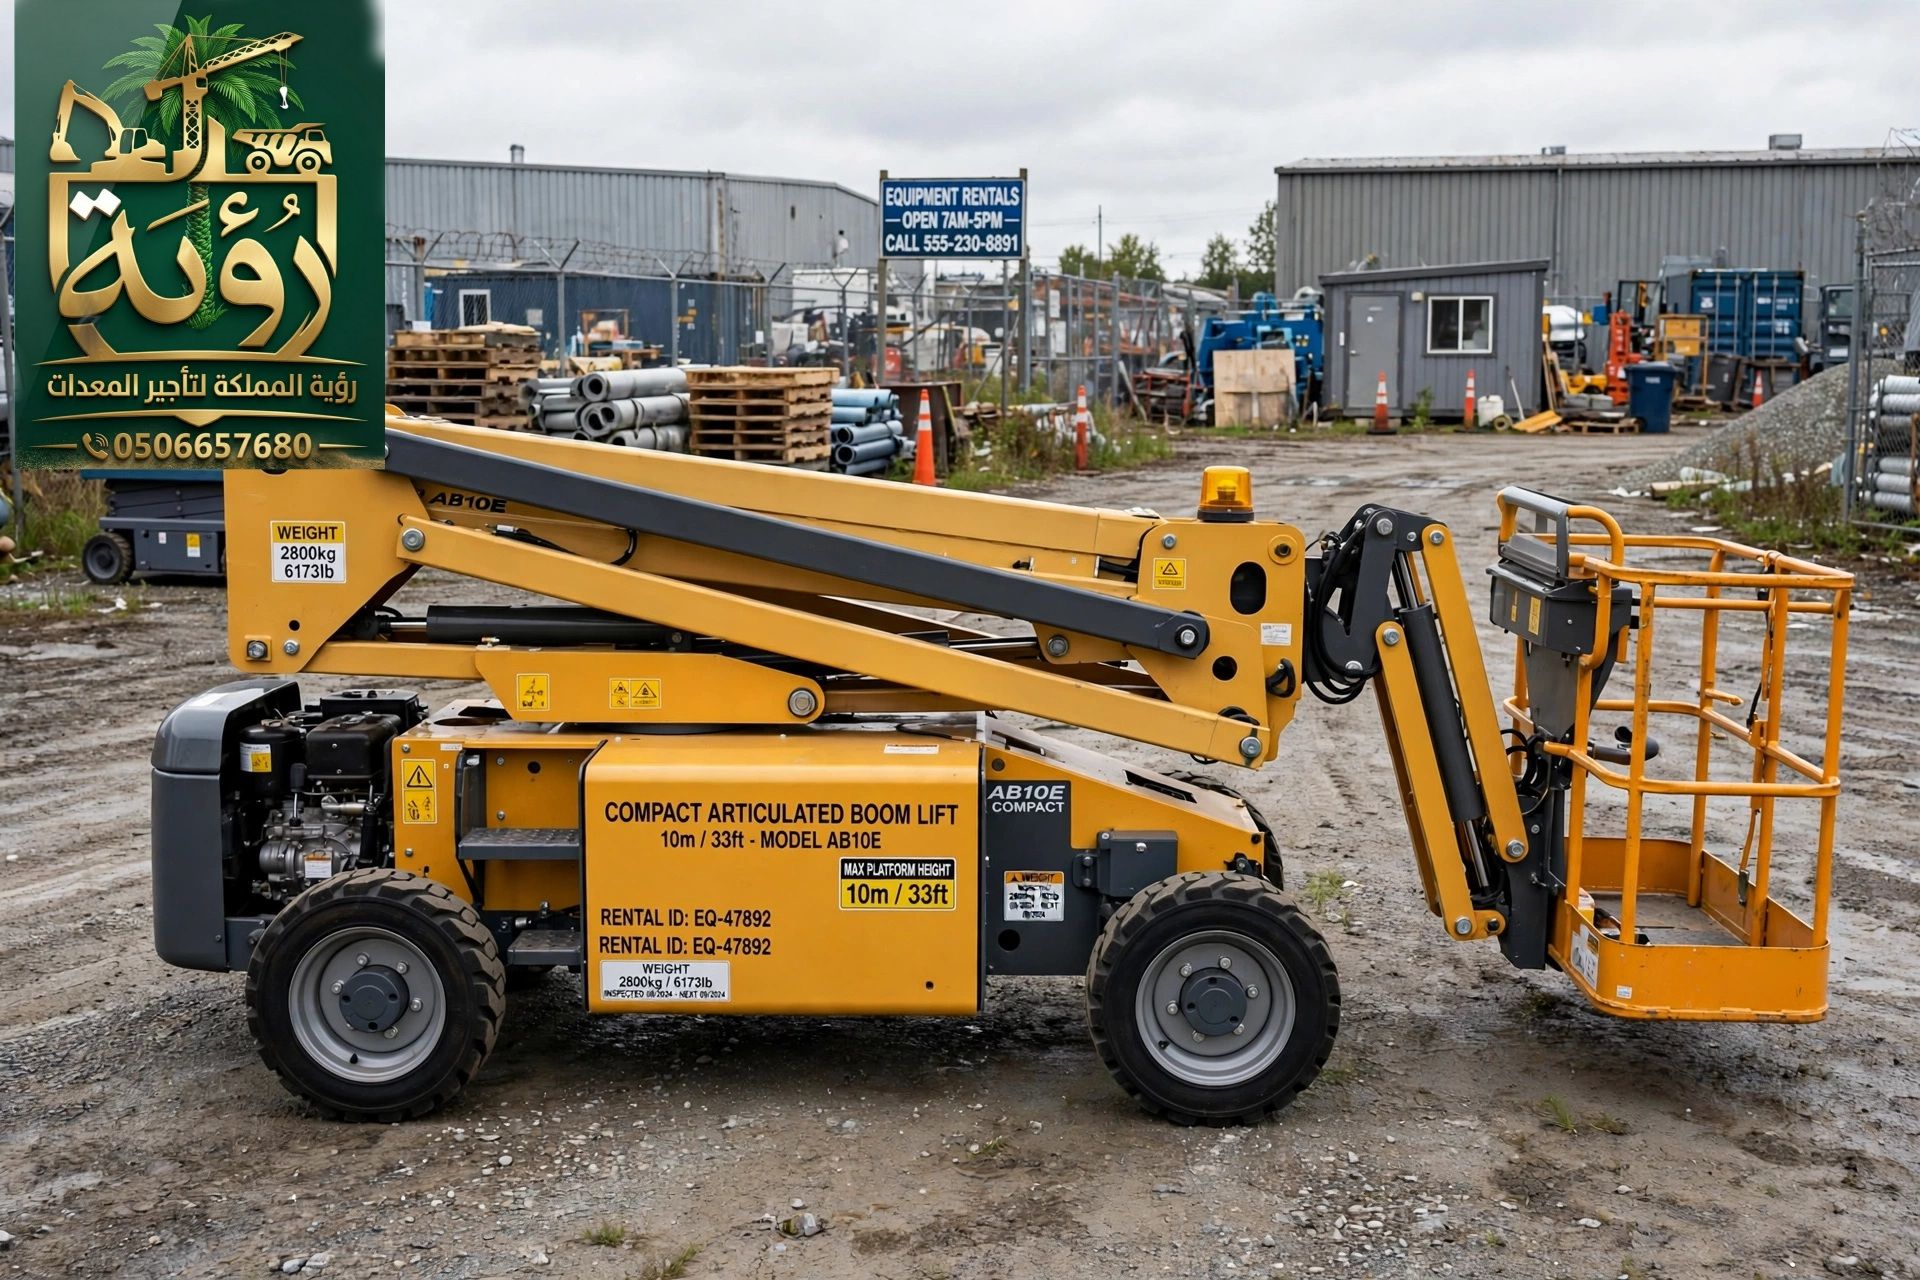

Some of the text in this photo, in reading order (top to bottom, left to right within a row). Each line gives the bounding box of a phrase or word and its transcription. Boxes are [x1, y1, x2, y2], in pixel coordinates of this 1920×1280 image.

[885, 186, 1020, 207] EQUIPMENT RENTALS
[902, 211, 1003, 229] OPEN 7AM-5PM
[885, 234, 1018, 252] CALL 555-230-8891
[428, 492, 507, 513] AB10E
[277, 525, 338, 540] WEIGHT
[280, 546, 336, 563] 2800kg
[284, 563, 335, 578] 6173lb
[986, 785, 1066, 800] AB10E
[604, 801, 959, 825] COMPACT ARTICULATED BOOM LIFT
[992, 801, 1065, 813] COMPACT
[660, 830, 695, 848] 10m
[700, 830, 707, 848] /
[711, 830, 744, 848] 33ft
[760, 830, 822, 848] MODEL
[826, 831, 881, 849] AB10E
[844, 862, 951, 877] MAX PLATFORM HEIGHT
[847, 883, 948, 905] 10m / 33ft
[601, 908, 771, 928] RENTAL ID: EQ-47892
[599, 936, 771, 956] RENTAL ID: EQ-47892
[642, 963, 690, 974] WEIGHT
[619, 975, 713, 990] 2800kg / 6173lb
